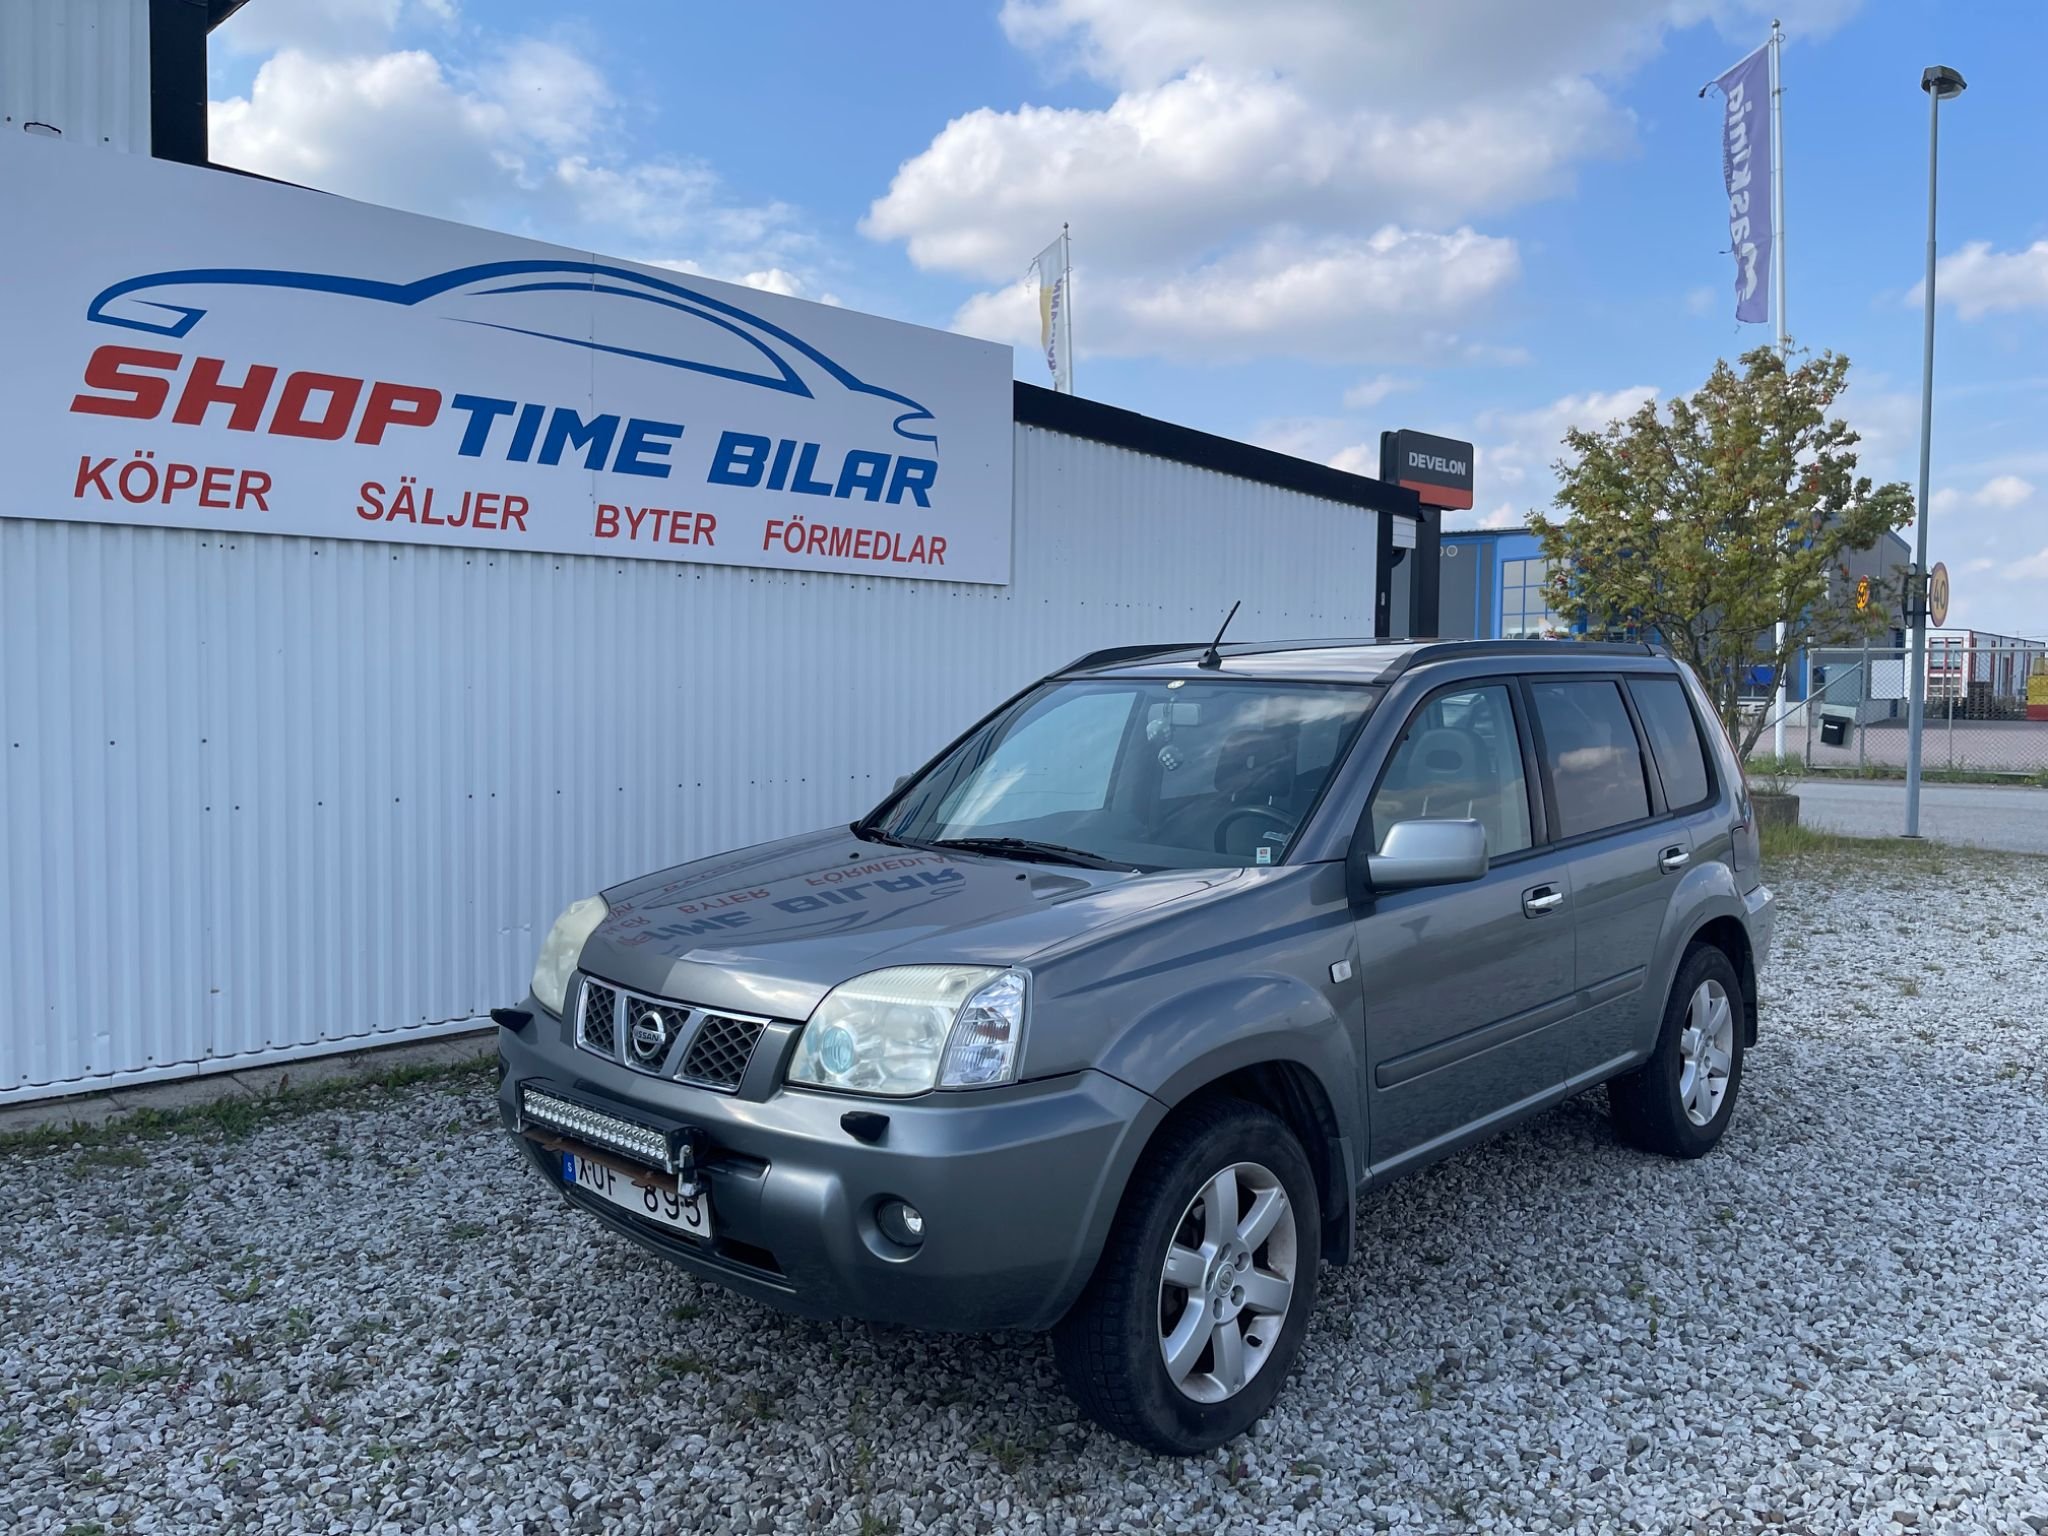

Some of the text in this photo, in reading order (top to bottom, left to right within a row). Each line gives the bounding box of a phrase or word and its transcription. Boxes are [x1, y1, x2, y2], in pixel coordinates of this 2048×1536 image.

[707, 431, 938, 507] BILAR
[1408, 451, 1466, 476] DEVELON
[75, 450, 946, 565] KÖPER SÄLJER BYTER FÖRMEDLAR
[1933, 579, 1946, 609] 40
[567, 1161, 573, 1173] S
